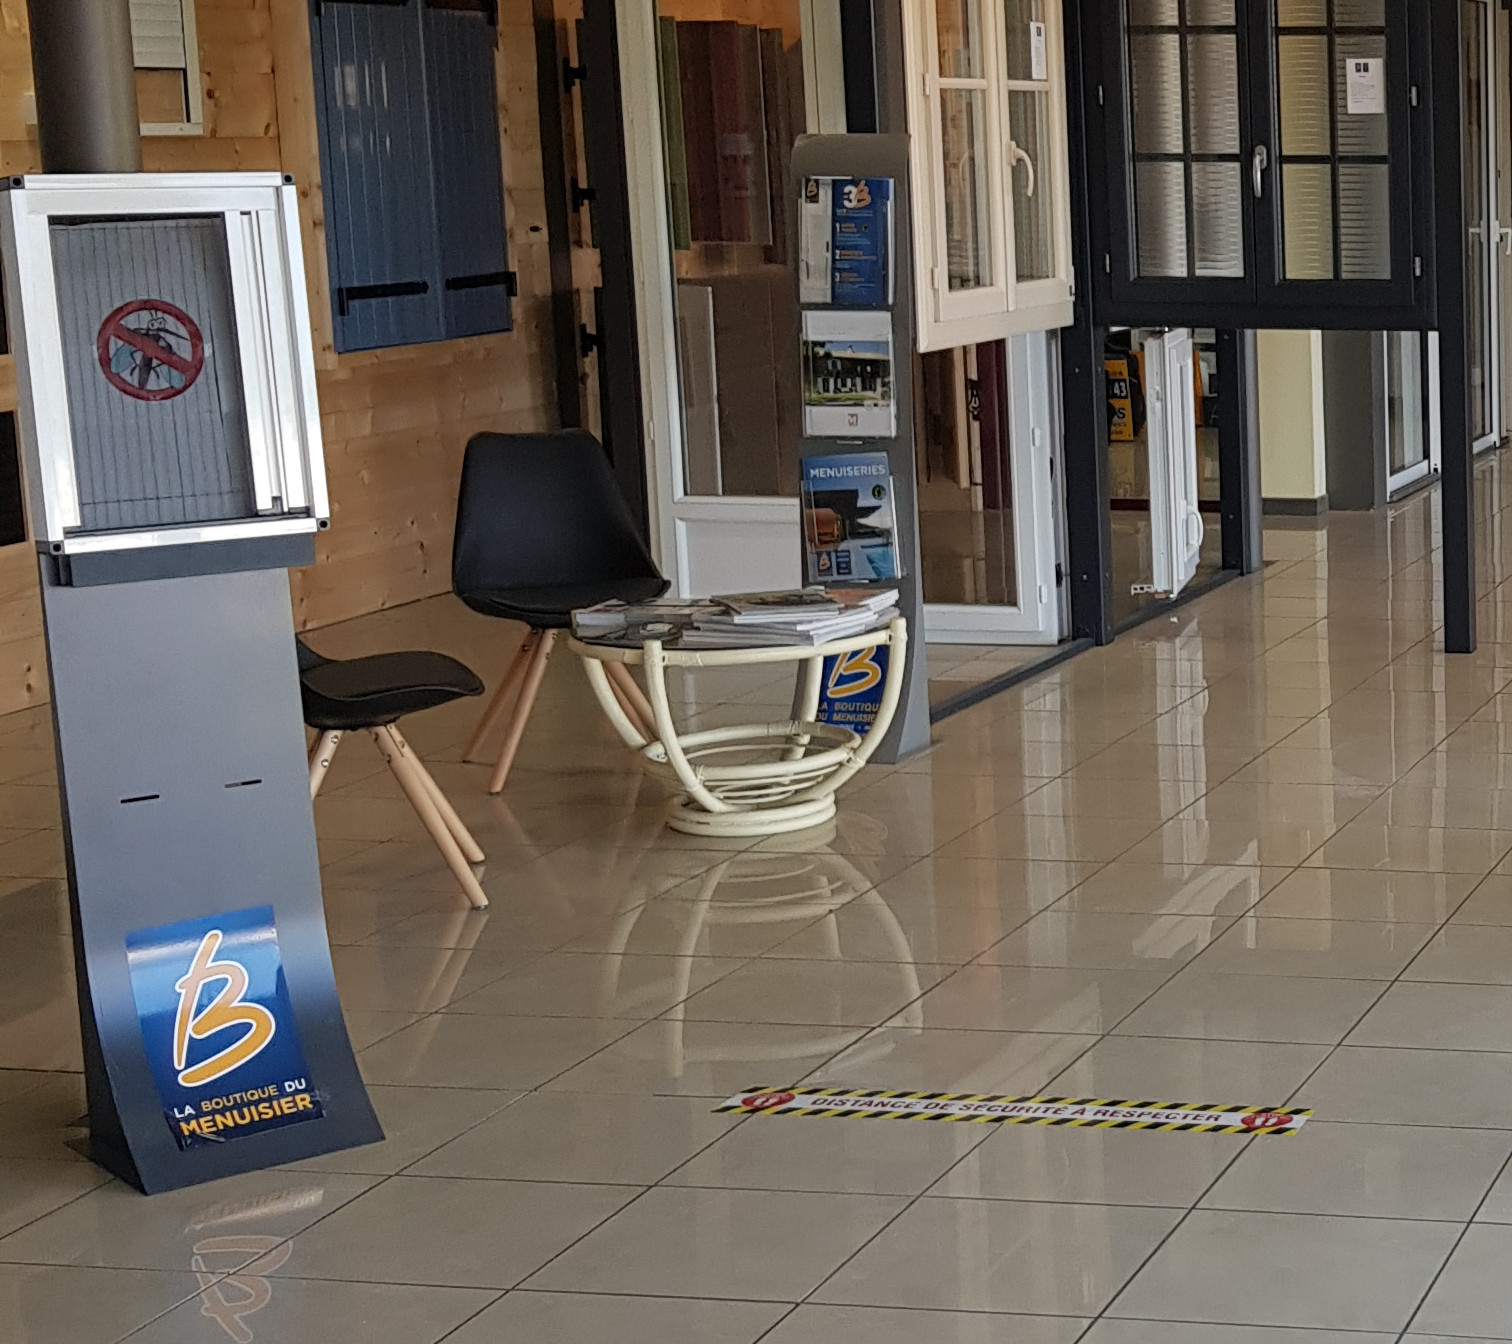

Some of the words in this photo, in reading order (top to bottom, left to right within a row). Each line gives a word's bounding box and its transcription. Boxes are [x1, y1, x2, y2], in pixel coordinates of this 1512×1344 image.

[809, 464, 886, 478] MENUISERIES
[834, 702, 879, 711] BOUTIQU
[173, 929, 276, 1089] B
[173, 1105, 196, 1118] LA
[201, 1084, 280, 1112] BOUTIQUE
[284, 1078, 306, 1093] DU
[180, 1093, 314, 1136] MENUISIER
[811, 1097, 914, 1110] DISTANCE
[922, 1100, 951, 1111] DE
[1092, 1107, 1222, 1123] RESPECTER
